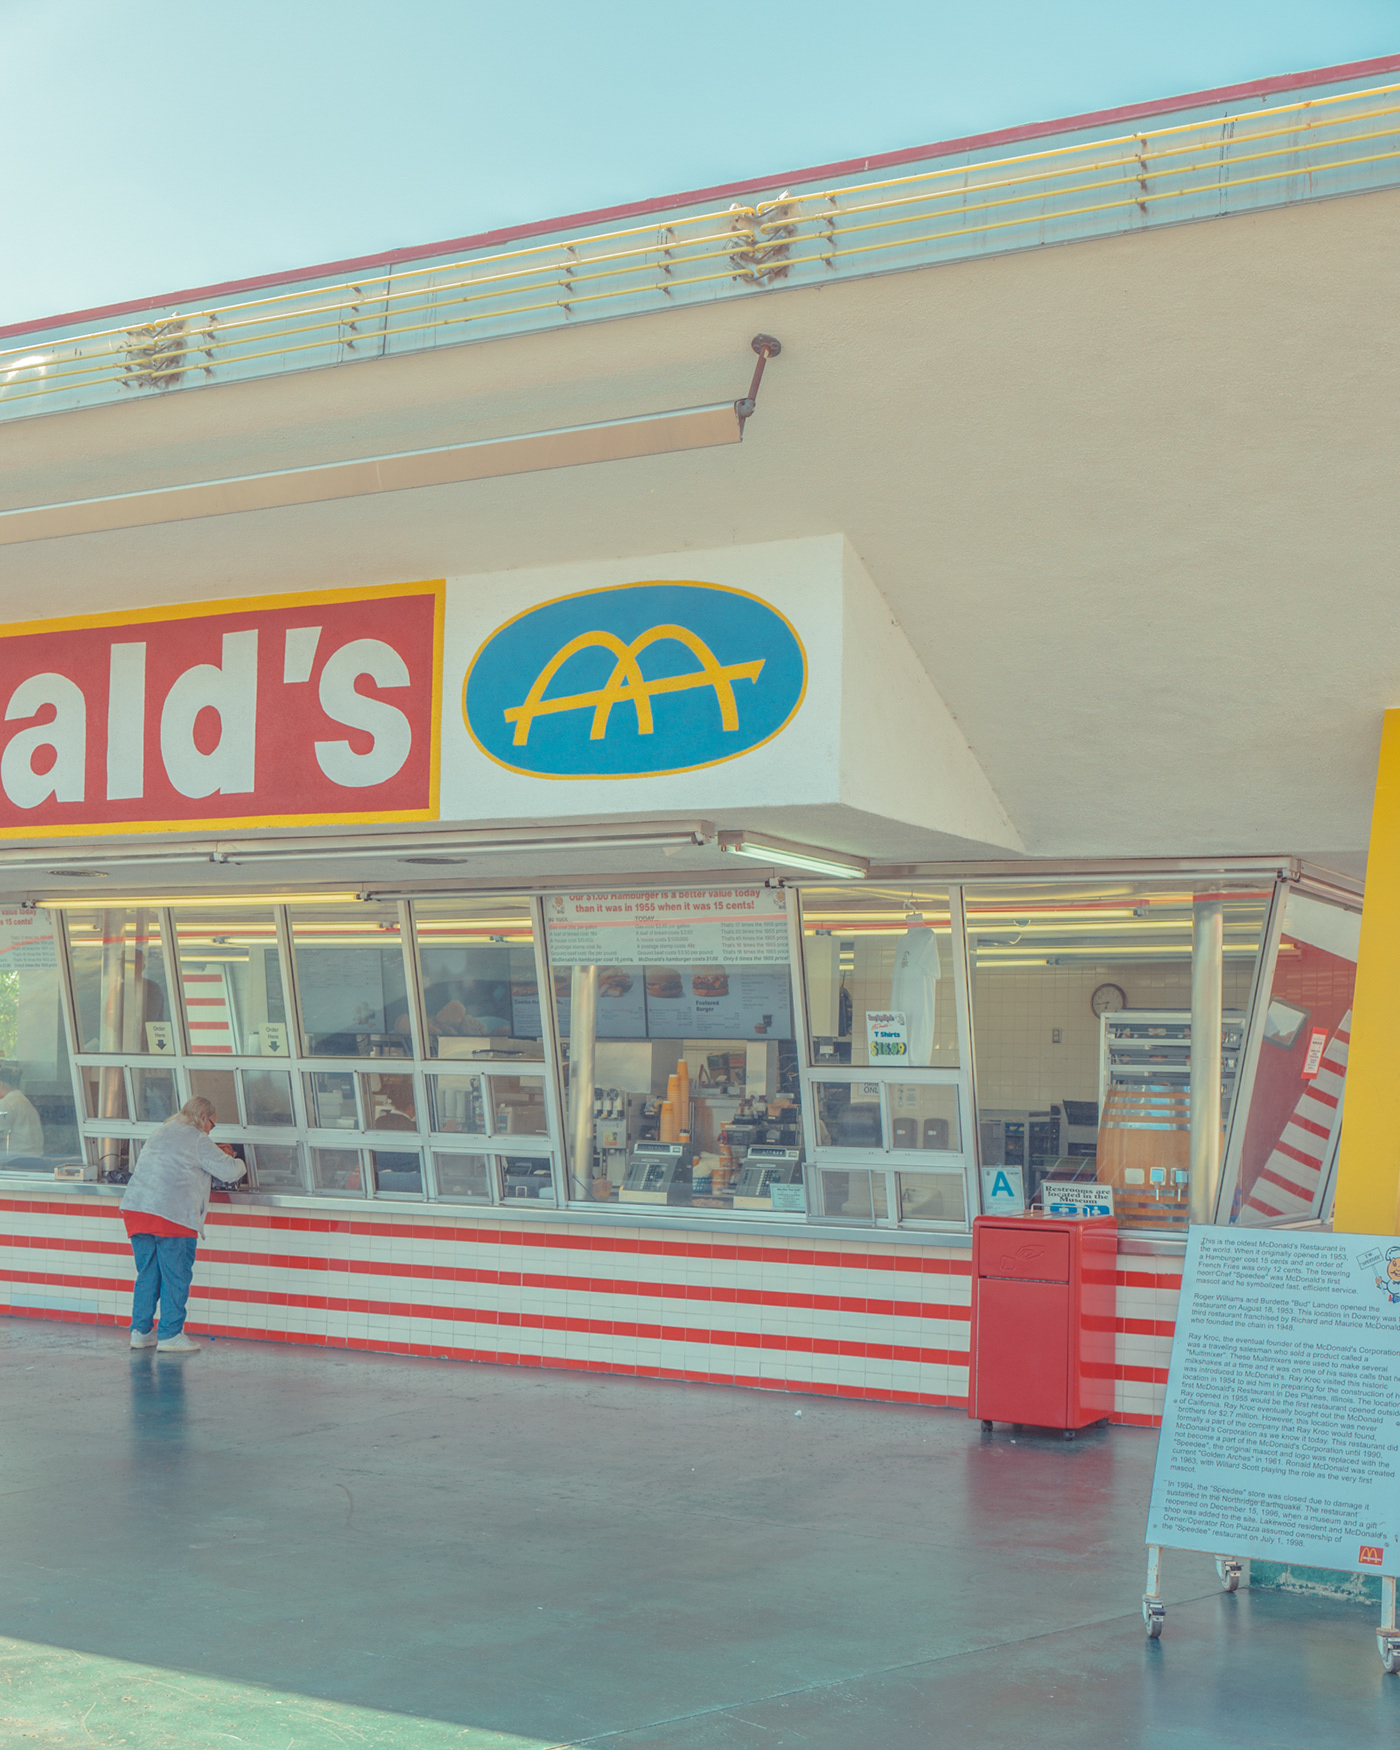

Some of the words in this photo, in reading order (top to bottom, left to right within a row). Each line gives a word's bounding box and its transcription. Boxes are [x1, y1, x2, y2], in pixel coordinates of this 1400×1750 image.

[611, 891, 659, 902] Hamburger
[661, 891, 669, 899] is
[678, 890, 706, 898] better
[708, 890, 733, 898] value
[734, 889, 760, 898] today
[575, 904, 595, 912] than
[596, 904, 603, 912] it
[624, 903, 633, 911] in
[634, 903, 655, 911] 1955
[658, 902, 682, 911] when
[684, 902, 690, 910] it
[713, 902, 724, 910] 15
[726, 901, 754, 910] cents!
[992, 1171, 1014, 1197] A
[1045, 1186, 1093, 1194] Restrooms
[1048, 1191, 1080, 1199] located
[1060, 1196, 1097, 1204] Museum
[1259, 1241, 1298, 1249] McDonald's
[1261, 1250, 1292, 1258] originally
[1321, 1269, 1350, 1278] towering
[1260, 1298, 1289, 1306] Burdette
[1312, 1301, 1338, 1309] Landon
[1238, 1305, 1262, 1313] August
[1314, 1310, 1341, 1318] location
[1351, 1312, 1381, 1321] Downey
[1206, 1318, 1233, 1326] founded
[1243, 1313, 1279, 1322] franchised
[1280, 1316, 1290, 1324] by
[1335, 1320, 1363, 1328] Maurice
[1175, 1423, 1215, 1433] McDonald's
[1217, 1427, 1257, 1437] Corporation
[1281, 1433, 1301, 1441] know
[1348, 1441, 1386, 1449] restaurant
[1163, 1516, 1218, 1527] Owner/Operator
[1236, 1524, 1260, 1532] Piazza
[1261, 1528, 1294, 1536] assumed
[1296, 1532, 1333, 1542] ownership
[1212, 1531, 1248, 1539] restaurant
[1260, 1535, 1275, 1544] July
